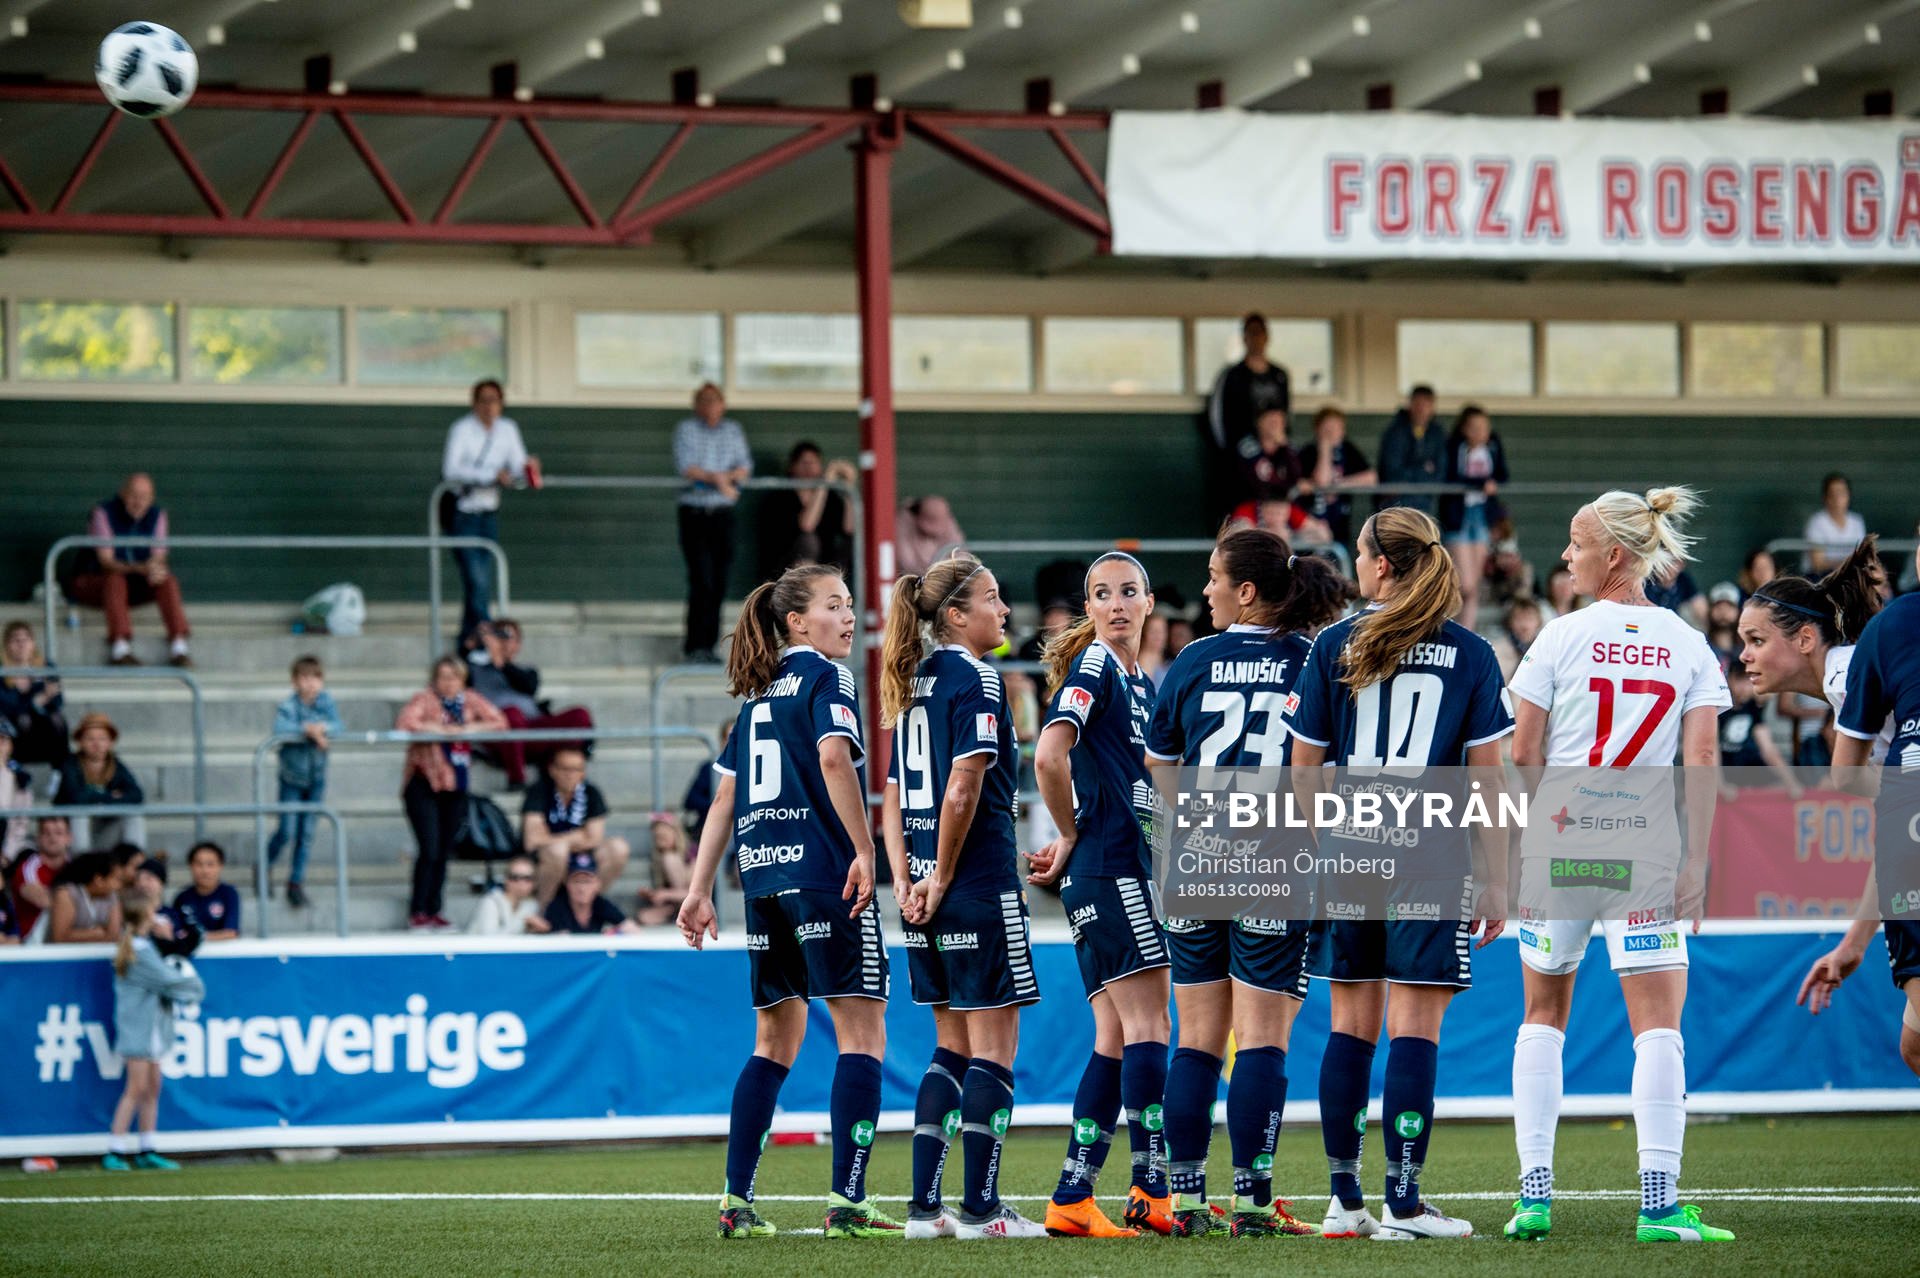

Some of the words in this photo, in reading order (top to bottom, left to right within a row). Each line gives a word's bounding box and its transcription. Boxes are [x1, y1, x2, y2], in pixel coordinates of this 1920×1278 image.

[1327, 156, 1567, 240] FORZA
[1211, 657, 1290, 684] BANUŠIĆ
[1592, 641, 1671, 668] SEGER
[1196, 691, 1288, 795] 23
[1347, 672, 1444, 778] 10
[1589, 677, 1676, 772] 17
[749, 702, 782, 804] 6
[1551, 859, 1604, 878] akea
[1243, 916, 1287, 931] QLEAN
[1397, 903, 1441, 916] QLEAN
[1628, 936, 1658, 950] MKB
[844, 1148, 867, 1198] Lundbergs
[1394, 1141, 1416, 1198] Lundbergs
